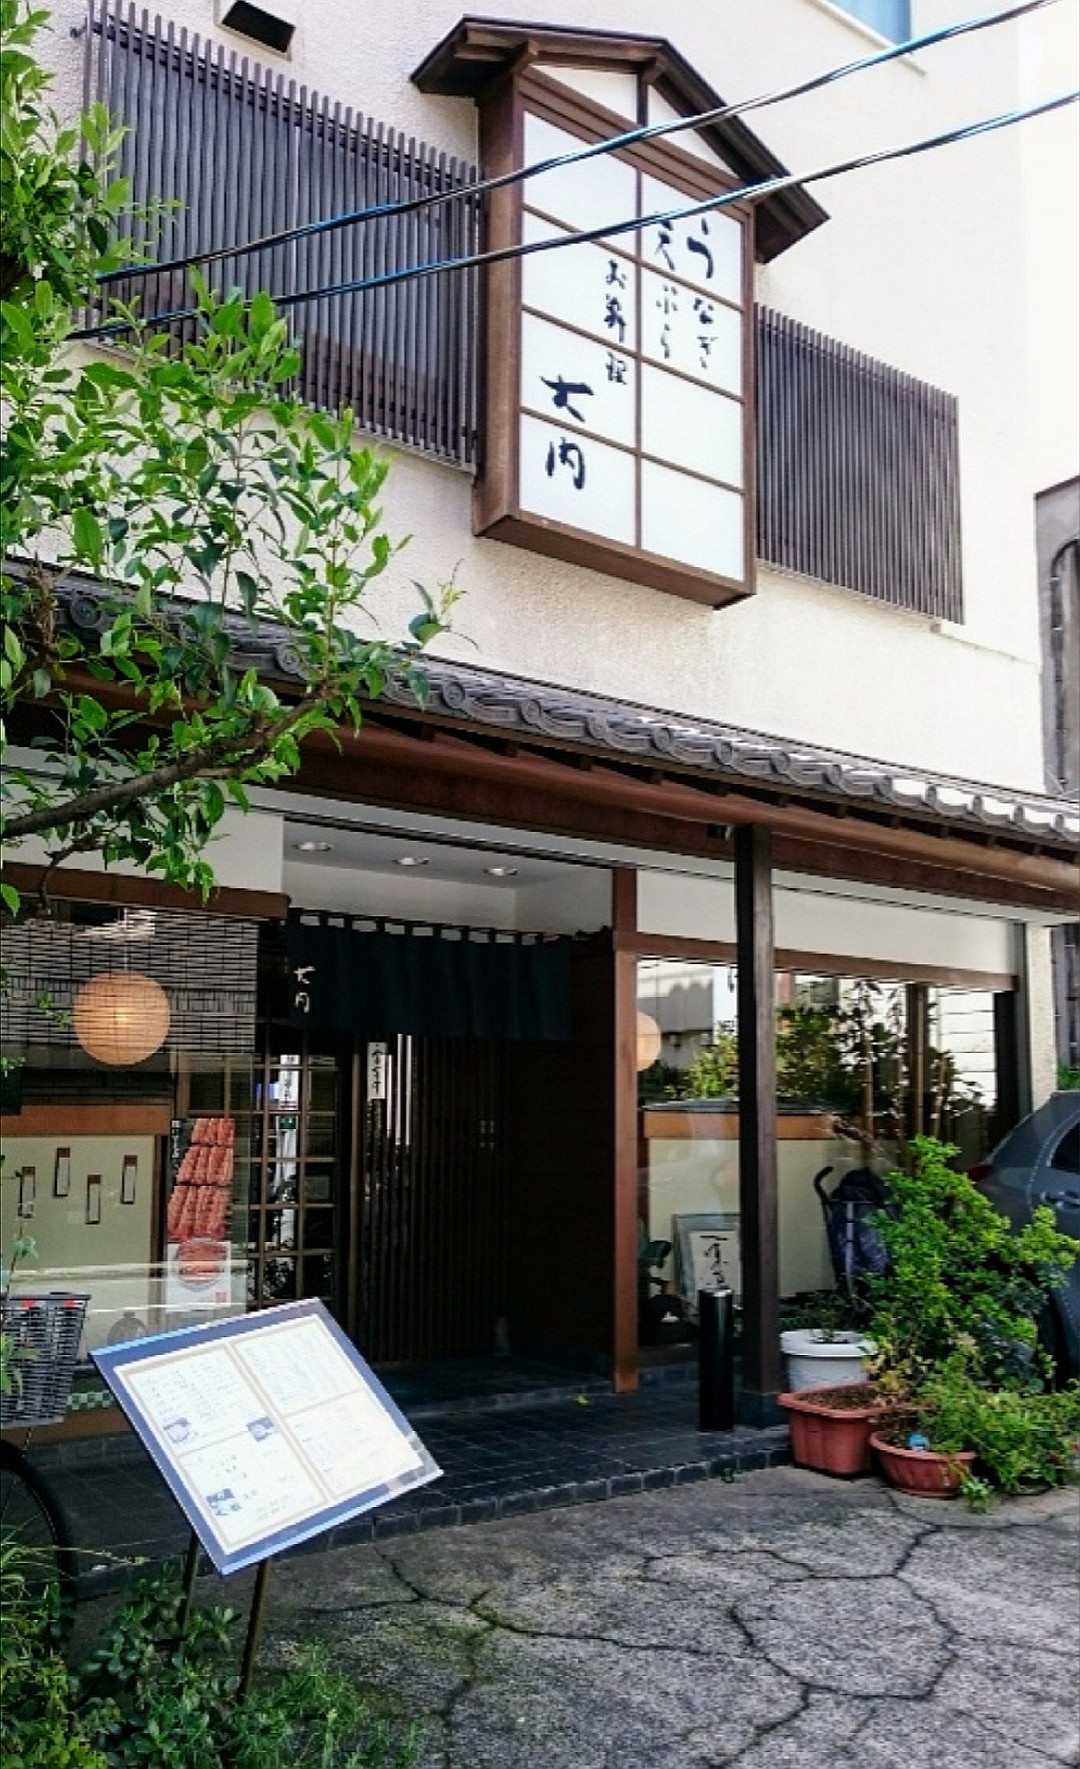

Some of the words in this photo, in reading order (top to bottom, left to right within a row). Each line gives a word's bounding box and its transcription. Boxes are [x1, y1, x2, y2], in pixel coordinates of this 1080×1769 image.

[604, 259, 627, 386] お料理
[654, 213, 678, 359] 天ぷら
[687, 218, 719, 369] うなぎ
[540, 374, 595, 490] 大内
[293, 966, 316, 1013] 大内
